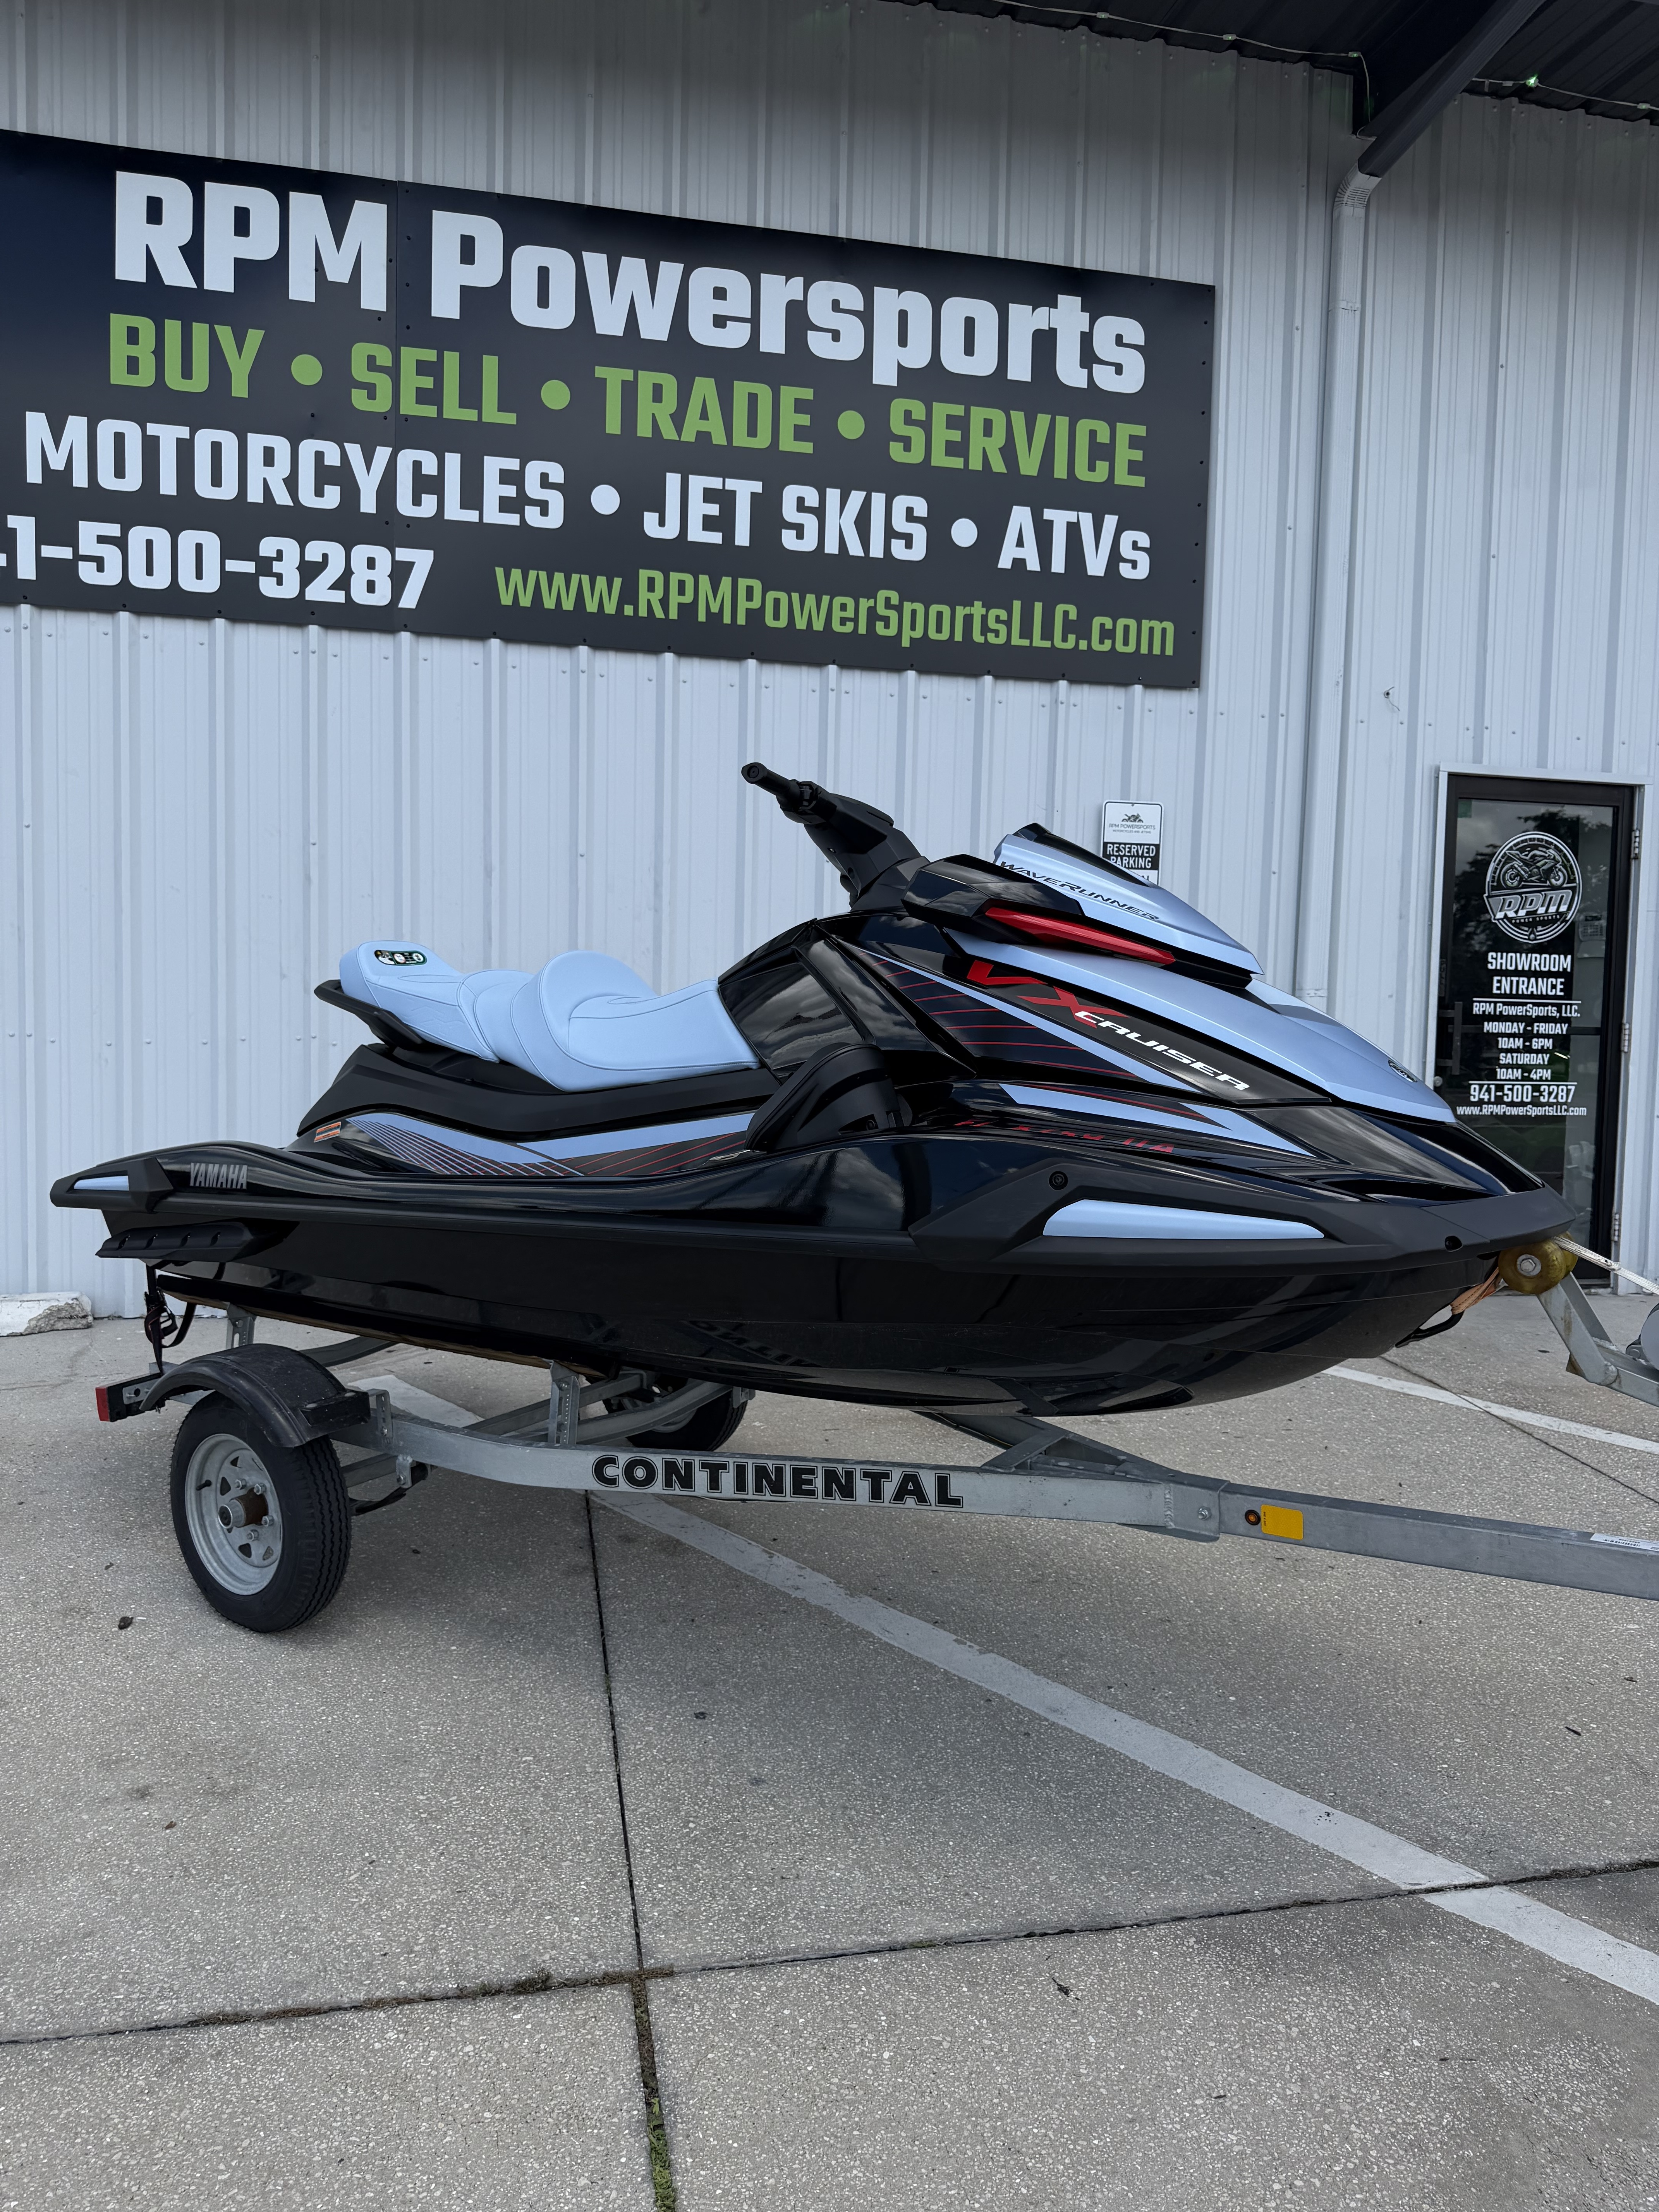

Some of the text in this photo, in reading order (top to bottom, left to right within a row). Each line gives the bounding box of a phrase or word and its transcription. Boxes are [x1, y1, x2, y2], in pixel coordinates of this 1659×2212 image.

[115, 170, 1146, 394] RPM Powersports
[110, 313, 1147, 488] BUY SELL TRADE SERVICE
[25, 411, 1151, 580] MOTORCYCLES JET SKIS ATVs
[0, 515, 434, 609] 1-500-3287
[494, 566, 1175, 656] www.RPMPowerSportsLLC.com
[1107, 844, 1156, 857] RESERVED
[1110, 856, 1152, 869] PARKING
[1000, 860, 1160, 921] WAVERUNNER
[1495, 890, 1572, 919] RPM
[1487, 952, 1571, 972] SHOWROOM
[966, 960, 1130, 1028] VX
[1492, 976, 1565, 996] ENTRANCE
[1472, 1002, 1580, 1018] RPM PowerSports, LLC.
[1483, 1022, 1525, 1034] MONDAY
[1533, 1022, 1568, 1035] FRIDAY
[1075, 1011, 1250, 1091] CRUISER
[1497, 1037, 1523, 1049] 10AM
[1532, 1038, 1553, 1049] 6PM
[1499, 1053, 1550, 1065] SATURDAY
[1496, 1068, 1522, 1080] 10AM
[1530, 1069, 1551, 1080] 4PM
[1470, 1084, 1575, 1103] 941-500-3287
[1456, 1105, 1587, 1117] www.RPMPowerSportsLLC.com
[190, 1163, 248, 1190] YAMAHA
[591, 1454, 963, 1508] CONTINENTAL
